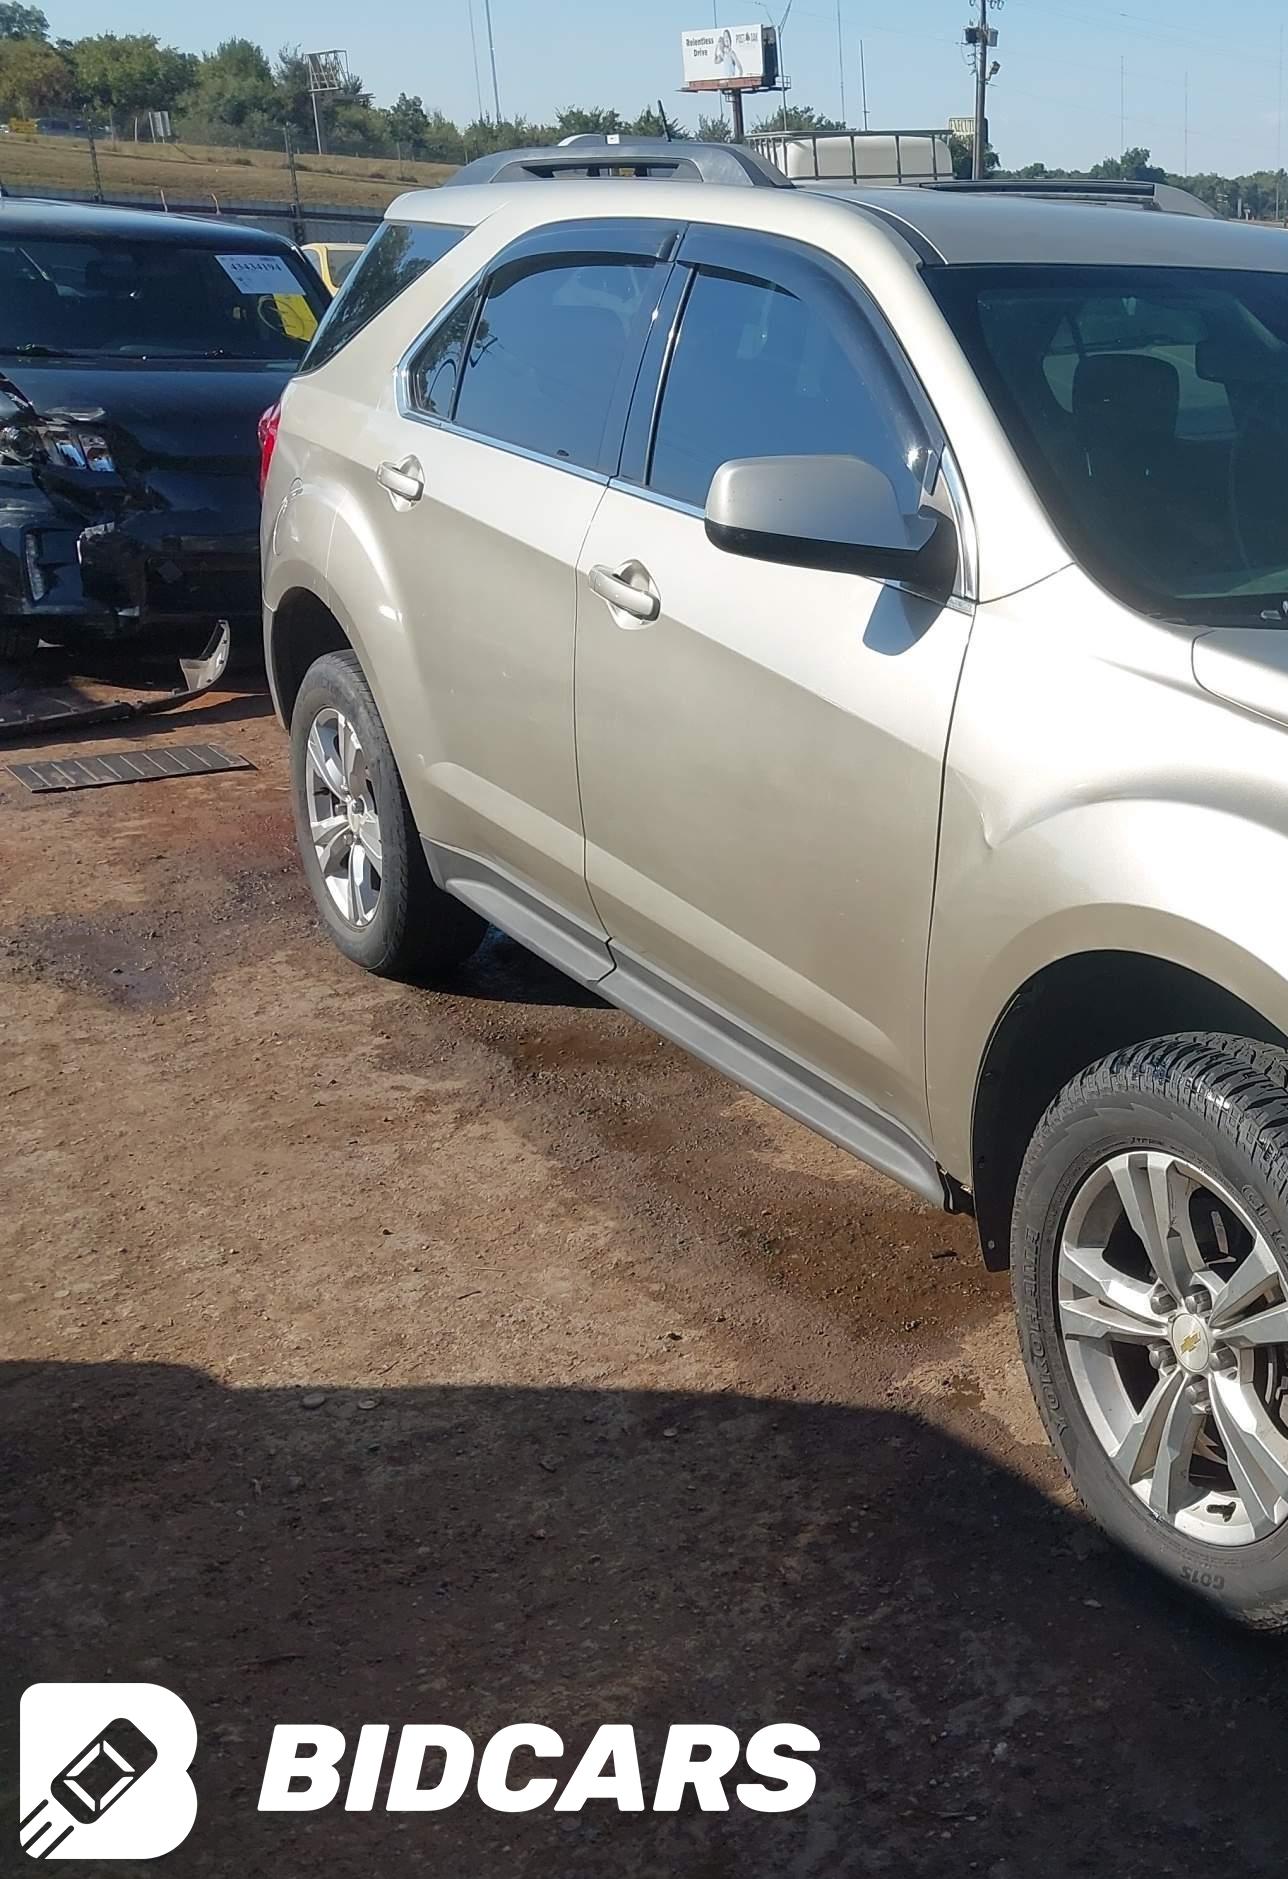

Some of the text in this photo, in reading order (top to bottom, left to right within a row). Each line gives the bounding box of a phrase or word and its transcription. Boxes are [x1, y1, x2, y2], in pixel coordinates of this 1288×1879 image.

[686, 37, 714, 47] Relentless
[693, 48, 708, 57] Drive
[1023, 1224, 1069, 1438] YOKOHAMA
